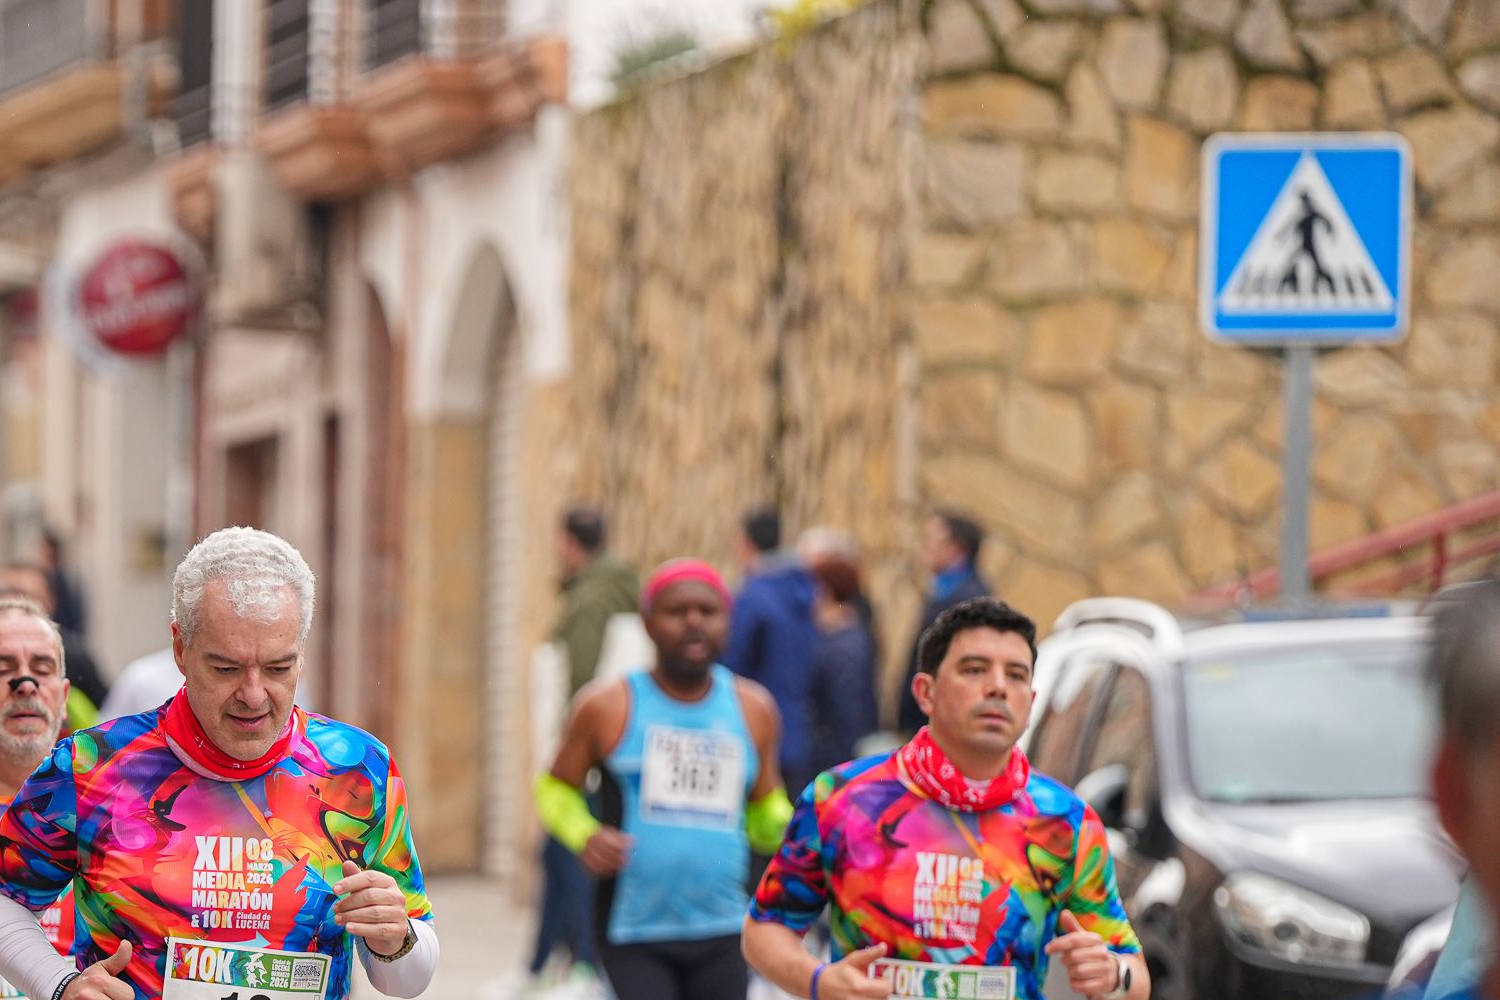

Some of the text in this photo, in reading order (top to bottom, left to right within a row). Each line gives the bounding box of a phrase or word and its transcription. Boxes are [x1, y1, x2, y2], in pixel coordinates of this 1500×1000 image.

[193, 836, 243, 871] XII
[246, 838, 274, 861] 08
[247, 862, 274, 871] MARZO
[193, 871, 245, 890] MEDIA
[247, 872, 274, 885] 2026
[192, 888, 273, 911] MARATÓN
[190, 910, 234, 929] & 10K
[236, 919, 269, 930] LUCENA
[184, 946, 235, 984] 10K
[270, 977, 289, 988] 2026
